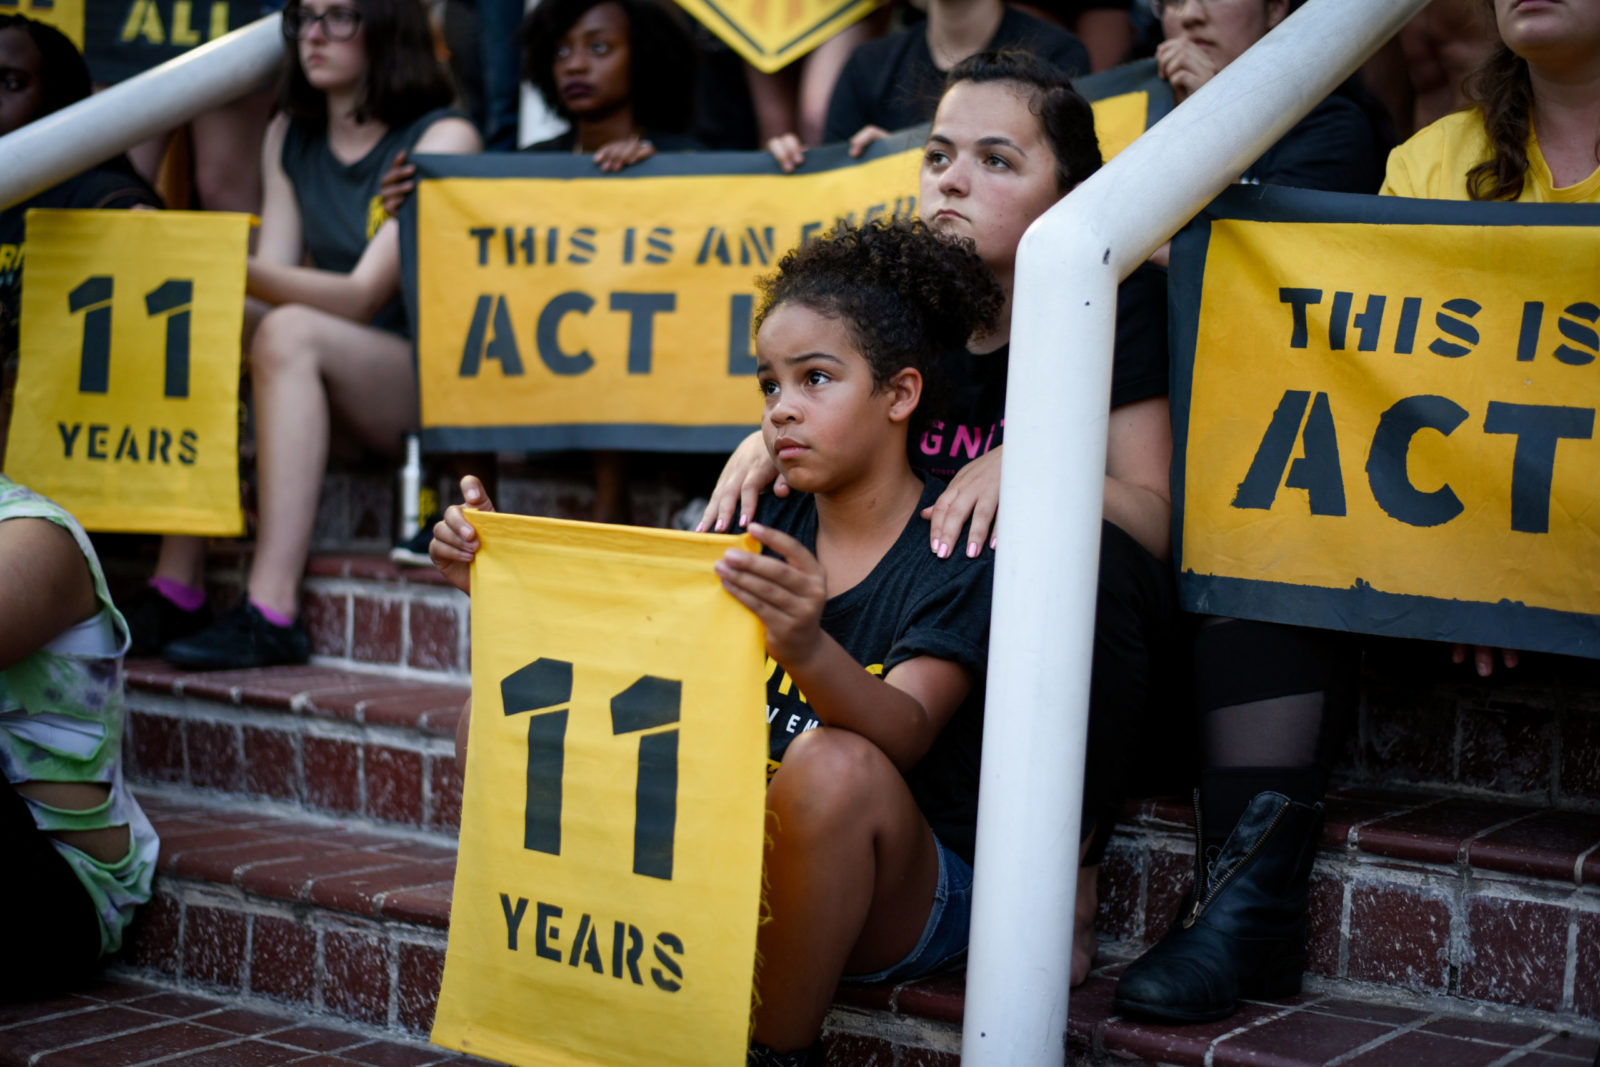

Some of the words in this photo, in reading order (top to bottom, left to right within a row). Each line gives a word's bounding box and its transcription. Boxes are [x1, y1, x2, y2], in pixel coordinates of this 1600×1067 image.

[470, 228, 597, 265] THIS
[624, 228, 674, 264] IS
[697, 227, 775, 266] AN
[68, 276, 193, 398] 11
[459, 291, 676, 377] ACT
[1278, 287, 1482, 358] THIS
[1516, 301, 1600, 366] IS
[58, 423, 198, 465] YEARS
[1231, 389, 1596, 534] ACT
[500, 657, 682, 881] 11
[499, 893, 684, 993] YEARS
